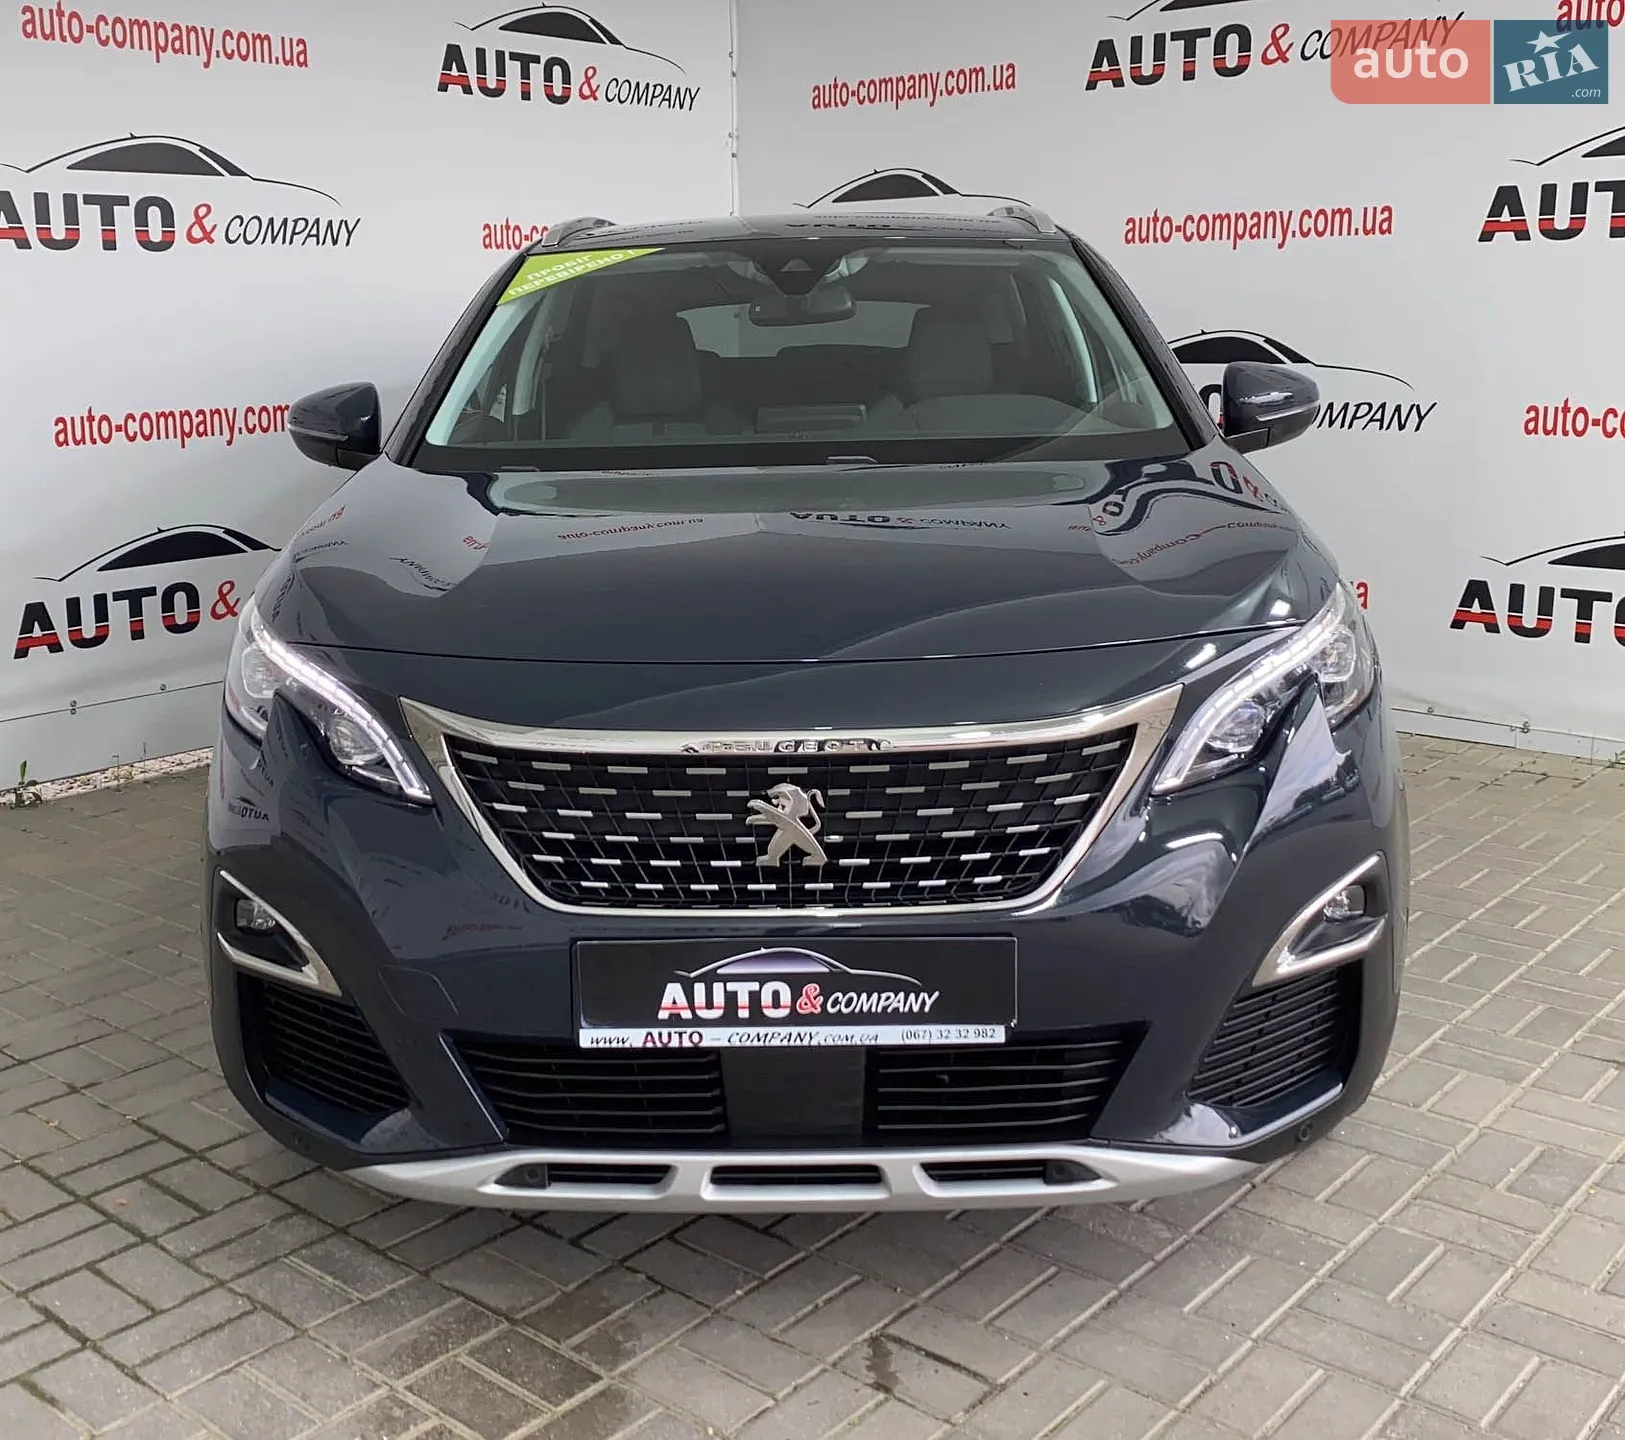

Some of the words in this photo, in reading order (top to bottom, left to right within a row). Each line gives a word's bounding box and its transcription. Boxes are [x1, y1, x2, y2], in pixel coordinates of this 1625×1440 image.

[21, 0, 309, 69] auto-company.com.ua
[1085, 23, 1252, 91] AUTO
[1261, 23, 1295, 67] &
[437, 43, 572, 105] AUTO
[578, 66, 600, 102] &
[604, 77, 700, 112] COMPANY
[811, 62, 1016, 110] auto-company.com.ua
[186, 203, 217, 245] &
[224, 214, 361, 247] COMPANY
[1124, 204, 1393, 250] auto-company.com.ua
[1311, 400, 1438, 432] MPANY
[1523, 397, 1625, 439] auto-c
[13, 581, 201, 660] AUTO
[209, 579, 241, 621] &
[1450, 579, 1625, 648] AUT
[657, 981, 791, 1020] AUTO
[795, 983, 824, 1015] &
[826, 991, 940, 1014] COMPANY
[642, 1031, 704, 1048] AUTO
[901, 1029, 932, 1042] (067)
[936, 1029, 950, 1041] 32
[955, 1028, 970, 1040] 32
[973, 1027, 996, 1040] 982
